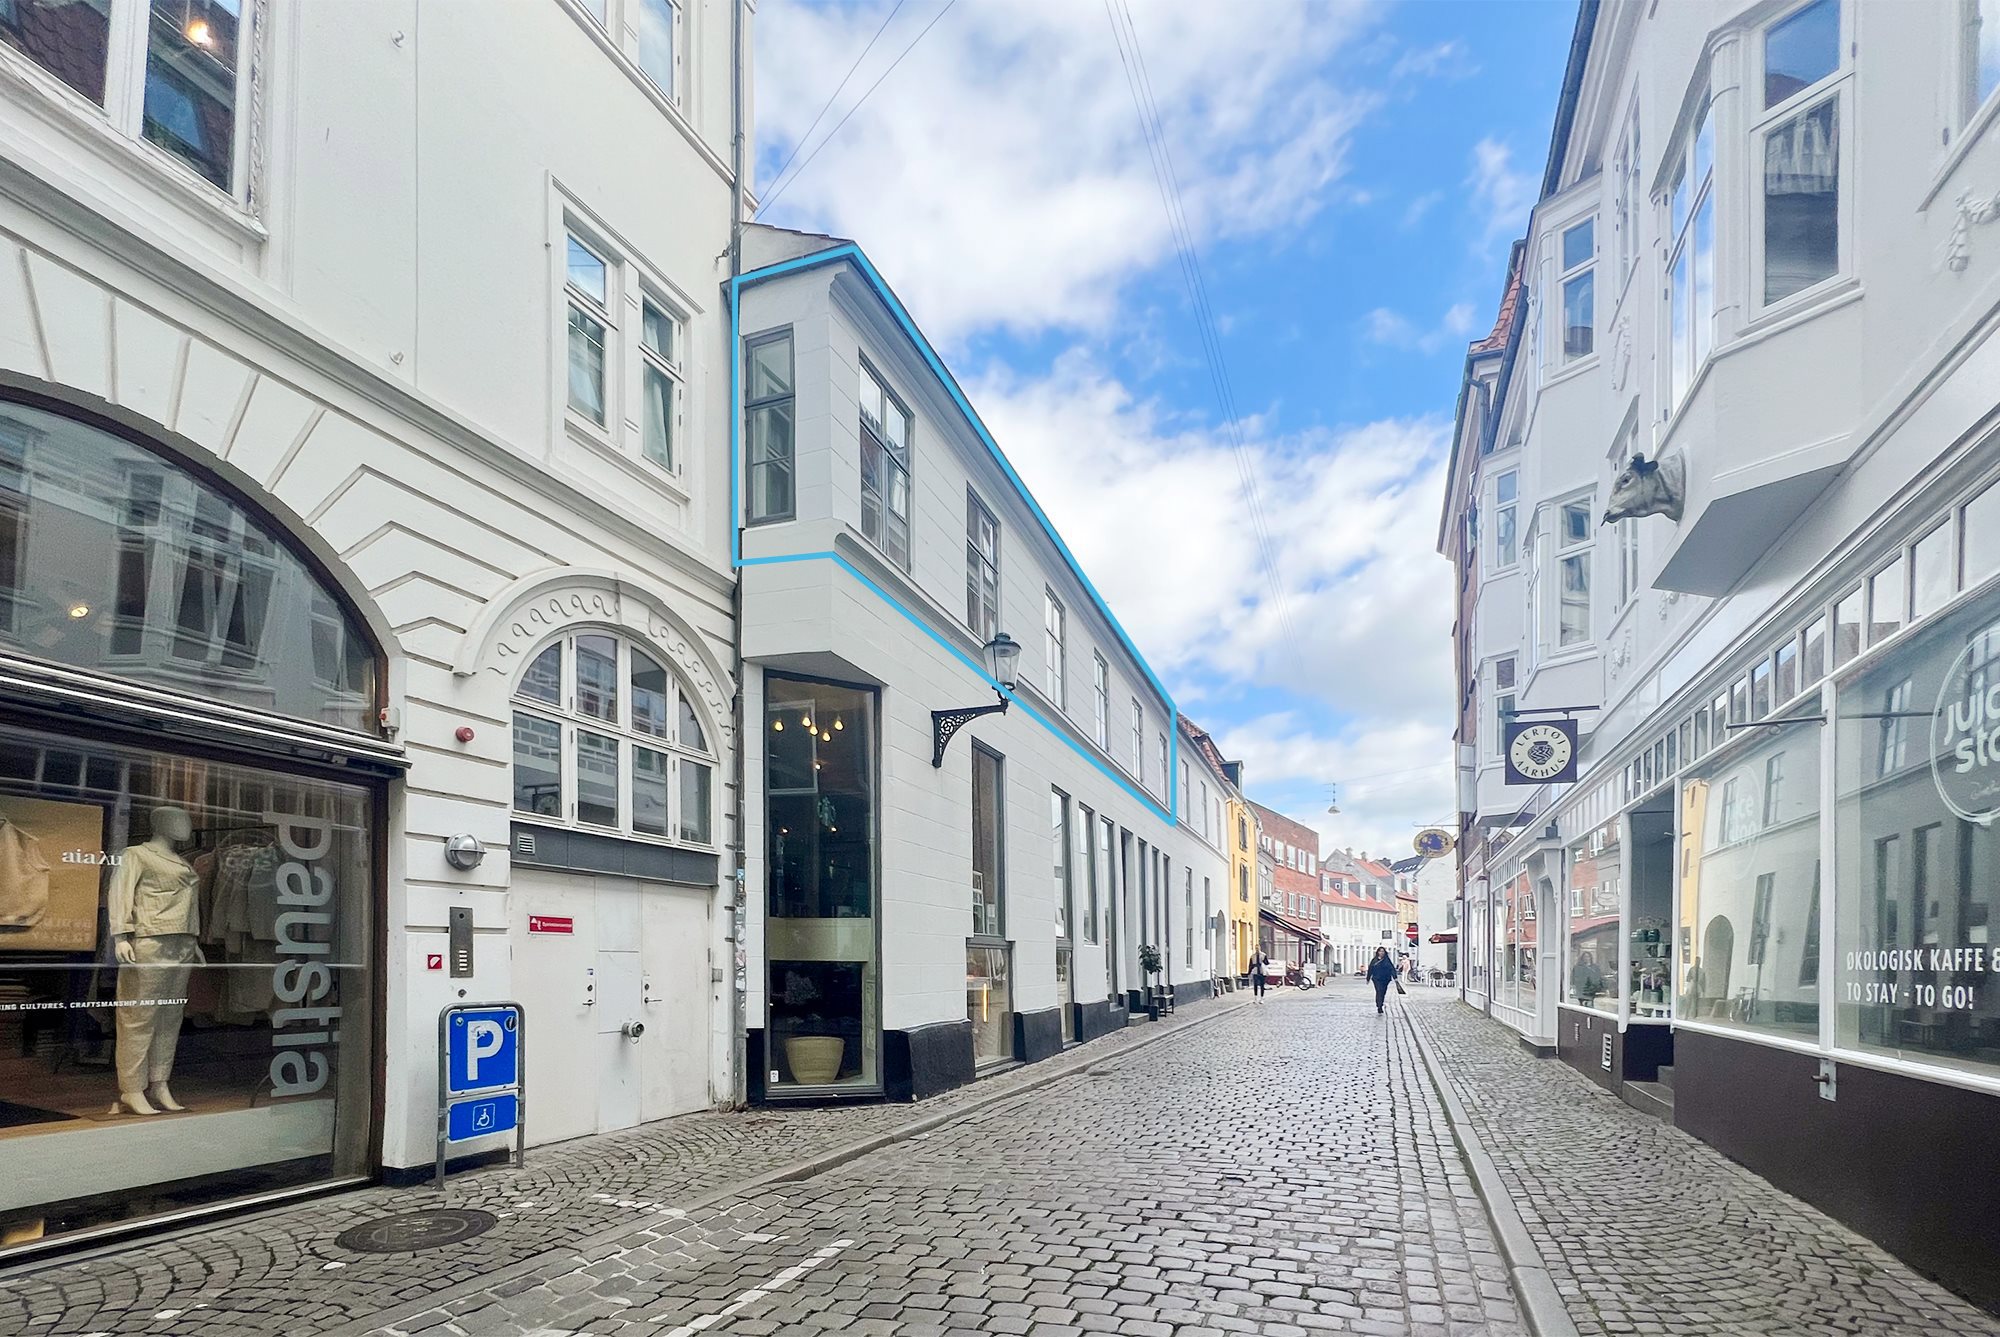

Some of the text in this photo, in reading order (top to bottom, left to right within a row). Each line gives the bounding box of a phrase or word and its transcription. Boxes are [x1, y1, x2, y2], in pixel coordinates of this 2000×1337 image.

[1515, 758, 1566, 778] AARHUS
[1846, 948, 1924, 972] ØKOLOGISK
[1930, 947, 1984, 972] KAFFE
[20, 1002, 67, 1010] CULTURES,
[69, 1000, 137, 1009] CRAFTSMANSHIP
[1846, 982, 1861, 1001] TO
[1866, 982, 1898, 1004] STAY
[1915, 984, 1936, 1007] TO
[1942, 985, 1974, 1010] GO!
[467, 1019, 504, 1081] P
